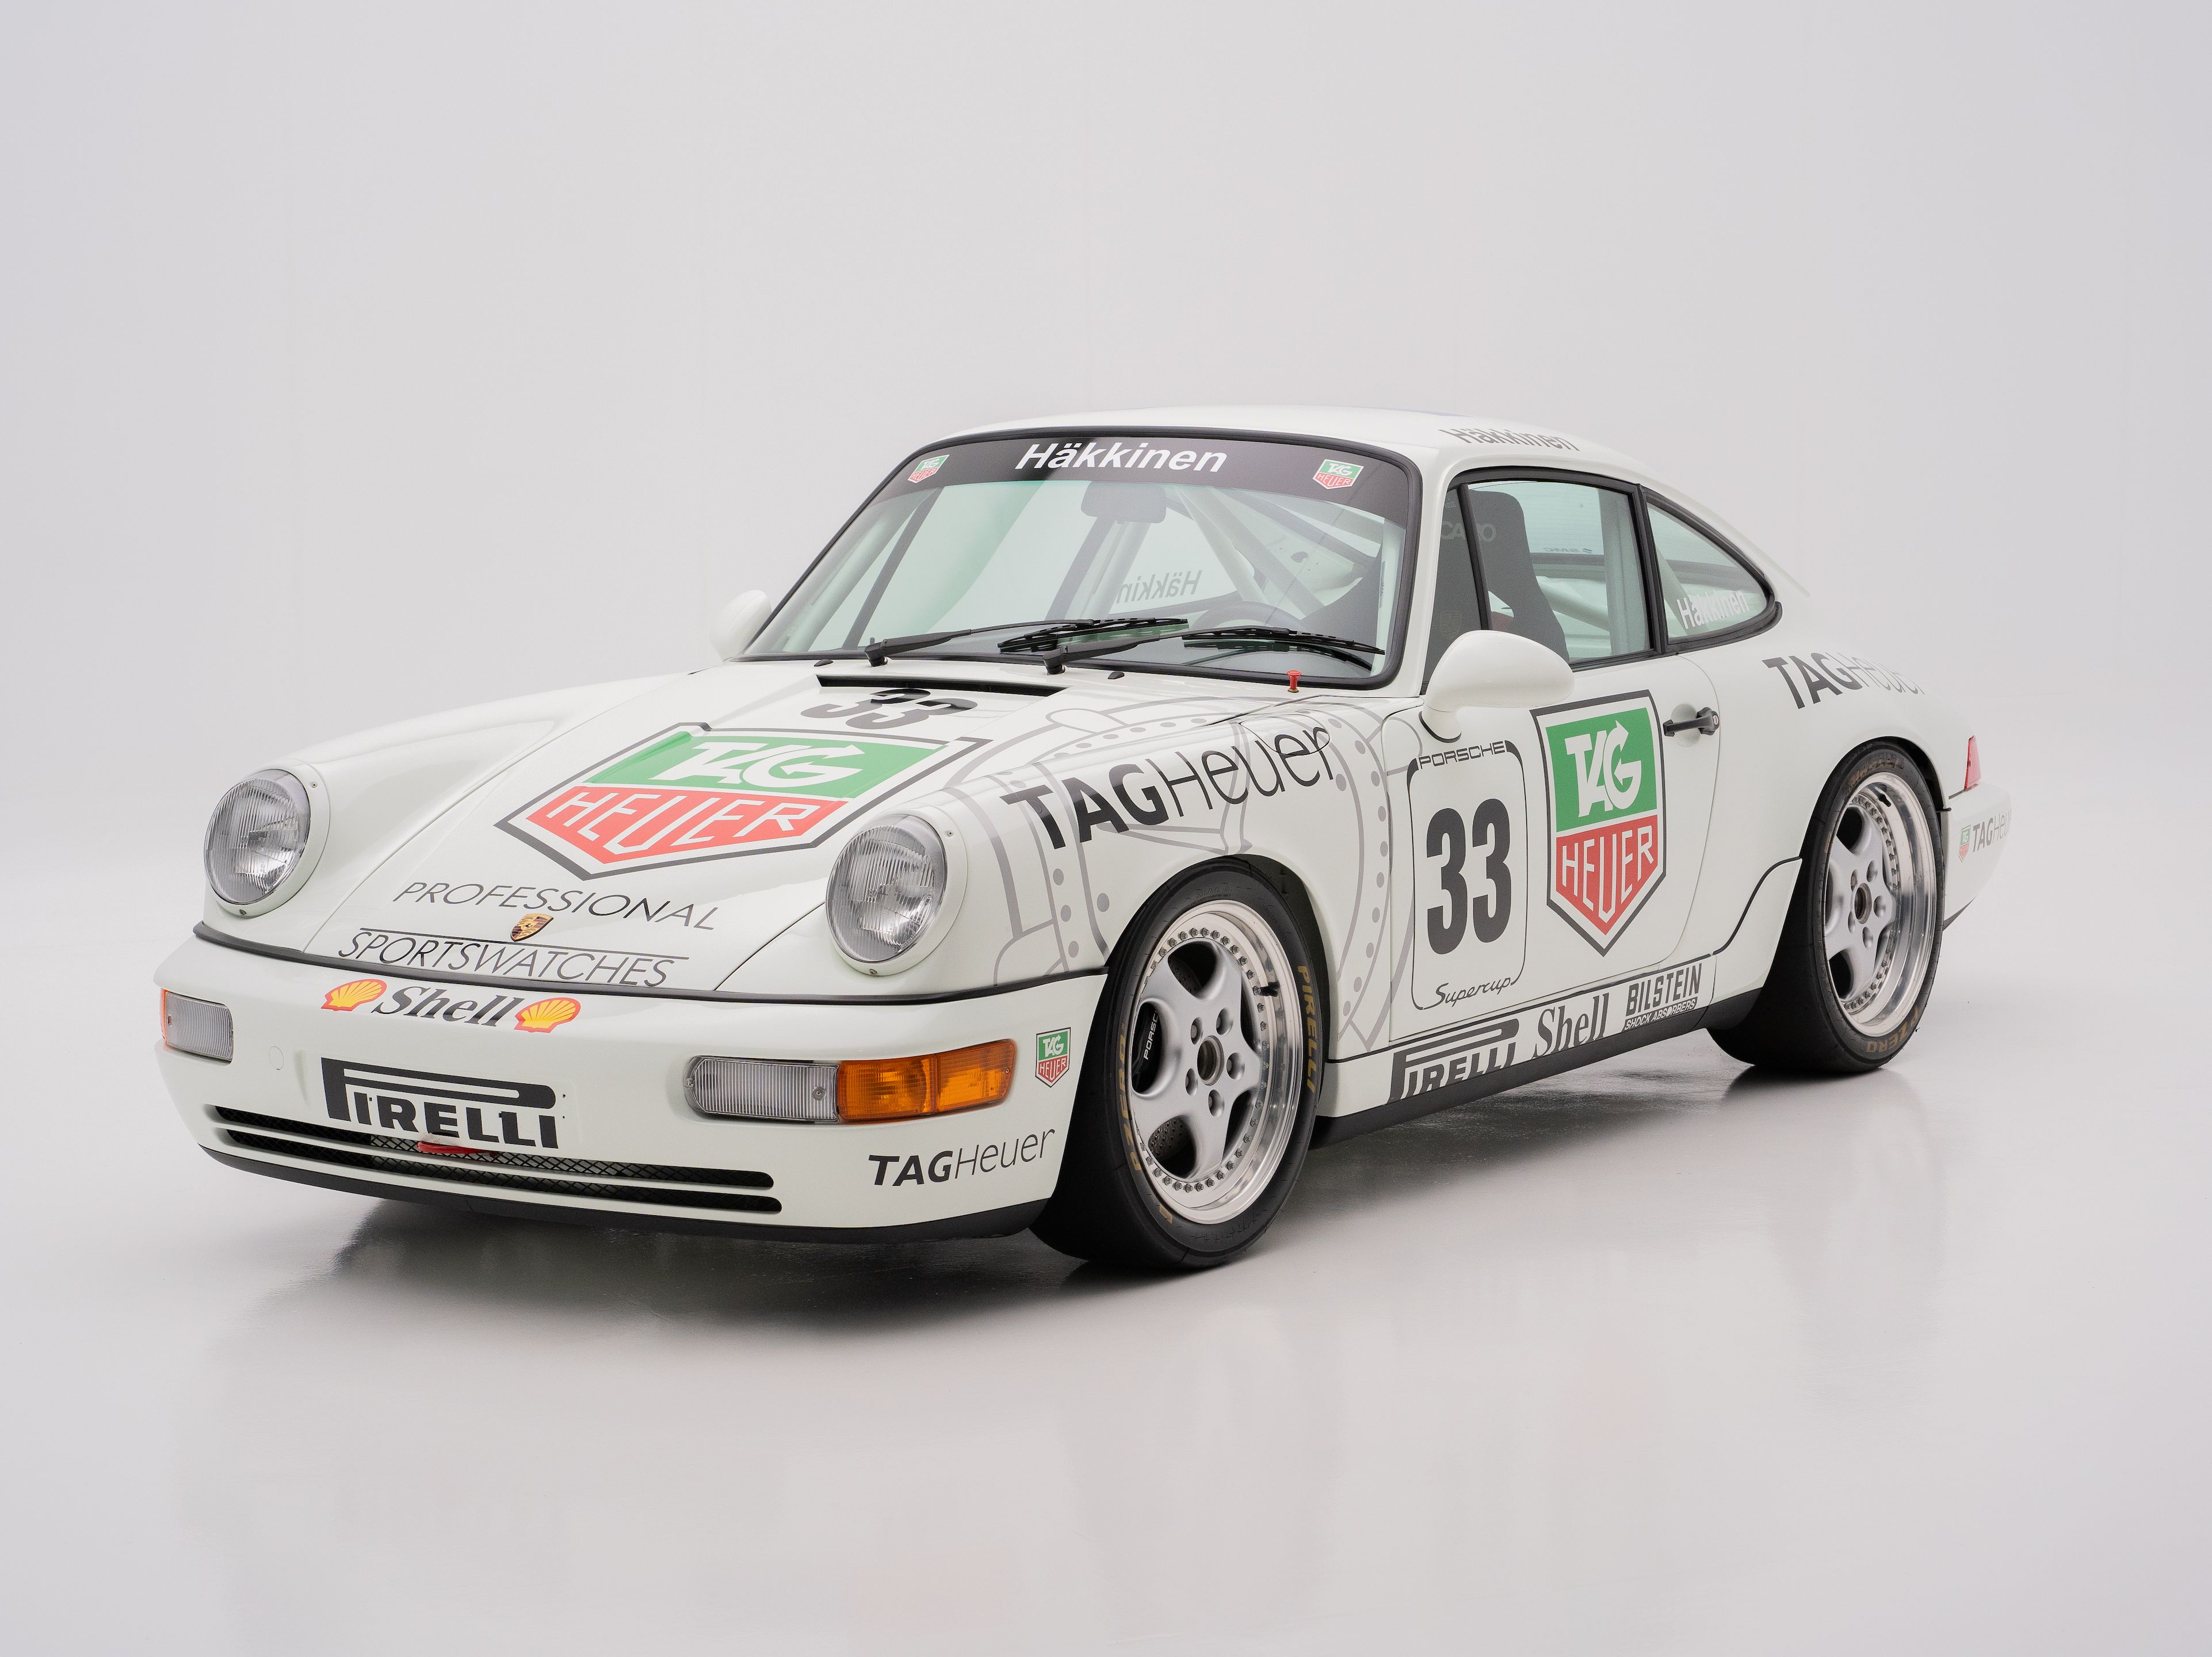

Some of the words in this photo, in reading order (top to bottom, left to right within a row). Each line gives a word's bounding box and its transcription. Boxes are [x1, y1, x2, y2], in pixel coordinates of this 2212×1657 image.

[1015, 444, 1228, 473] Häkkinen
[1437, 428, 1581, 452] Häkkinen
[910, 468, 936, 481] HEUER
[920, 458, 941, 470] TAG
[1317, 473, 1351, 487] HEUER
[1327, 463, 1353, 476] TAG
[801, 689, 977, 730] 33
[650, 740, 866, 788] TAG
[1419, 740, 1506, 770] PORSCHE
[1565, 719, 1642, 818] TAG
[547, 791, 820, 855] HEUER
[1426, 798, 1512, 955] 33
[1561, 824, 1654, 923] HEUER
[392, 881, 719, 930] PROFESSIONAL
[338, 931, 678, 988] SPORTSWATCHES
[372, 985, 525, 1028] Shell
[1435, 977, 1511, 1007] Supercup
[1625, 963, 1702, 1017] BILSTEIN
[1143, 1012, 1159, 1060] PORSC
[1297, 965, 1317, 1094] PIRELLI
[1531, 992, 1610, 1060] Shell
[1623, 1011, 1652, 1031] SHOCK
[1651, 998, 1697, 1023] ABSORBERS
[1042, 1033, 1064, 1057] TAG
[1386, 1018, 1520, 1104] PIRELLI
[1040, 1057, 1067, 1081] HEUER
[320, 1057, 558, 1149] PIRELLI
